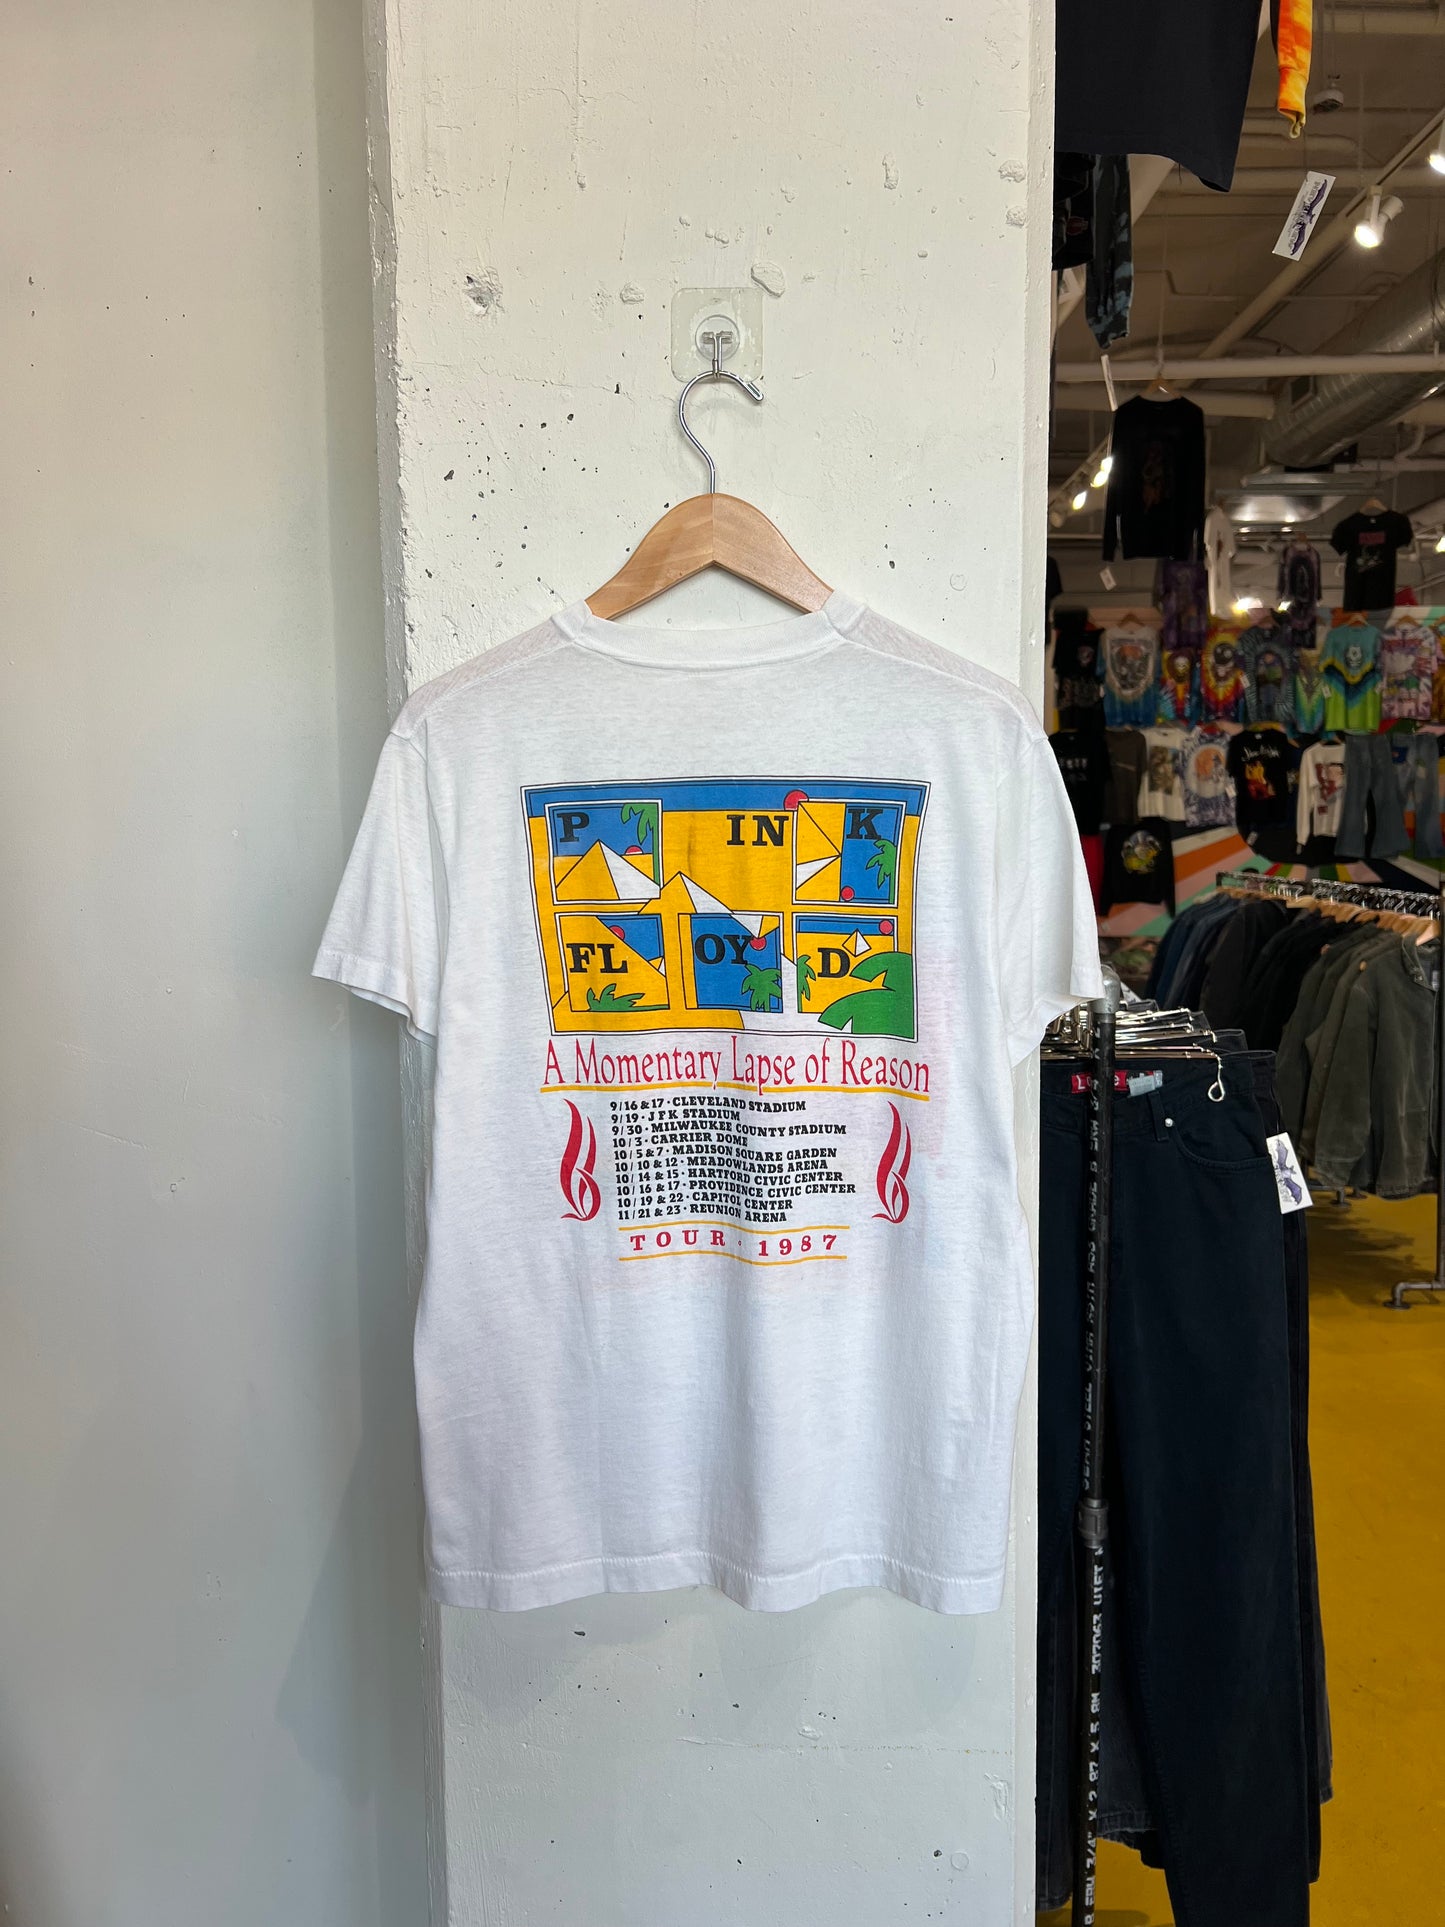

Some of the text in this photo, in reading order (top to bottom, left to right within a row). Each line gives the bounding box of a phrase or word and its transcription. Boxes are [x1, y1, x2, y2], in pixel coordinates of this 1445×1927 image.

[556, 812, 590, 844] P
[845, 807, 884, 840] K
[566, 933, 850, 979] FL OY D
[543, 1035, 930, 1096] A Momentary Lapse of Reason
[640, 1100, 650, 1110] &
[651, 1098, 664, 1108] 17
[672, 1096, 746, 1109] CLEVELAND
[748, 1101, 806, 1113] STADIUM
[682, 1108, 740, 1120] STADIUM
[651, 1120, 732, 1133] MILWAUKEE
[736, 1123, 786, 1137] COUNTY
[788, 1124, 847, 1136] STADIUM
[650, 1132, 713, 1145] CARRIER
[716, 1132, 748, 1147] DOME
[645, 1148, 655, 1158] &
[656, 1147, 664, 1156] 7
[672, 1144, 733, 1156] MADISON
[735, 1147, 783, 1162] SQUARE
[786, 1147, 837, 1161] GARDEN
[653, 1159, 662, 1169] &
[665, 1157, 678, 1167] 12
[687, 1156, 784, 1174] MEADOWLANDS
[787, 1159, 828, 1173] ARENA
[655, 1171, 664, 1181] &
[666, 1169, 679, 1179] 15
[688, 1168, 750, 1184] HARTFORD
[754, 1175, 791, 1186] CIVIC
[794, 1171, 843, 1183] CENTER
[656, 1183, 665, 1192] &
[667, 1181, 680, 1191] 17
[689, 1179, 763, 1197] PROVIDENCE
[767, 1186, 802, 1198] CIVIC
[805, 1183, 856, 1194] CENTER
[657, 1195, 666, 1204] &
[669, 1192, 684, 1203] 22
[692, 1191, 741, 1206] CAPITOL
[744, 1198, 793, 1210] CENTER
[654, 1207, 663, 1217] &
[666, 1205, 681, 1215] 23
[689, 1203, 741, 1219] REUNION
[744, 1210, 787, 1223] ARENA
[630, 1229, 837, 1257] TOUR 1987
